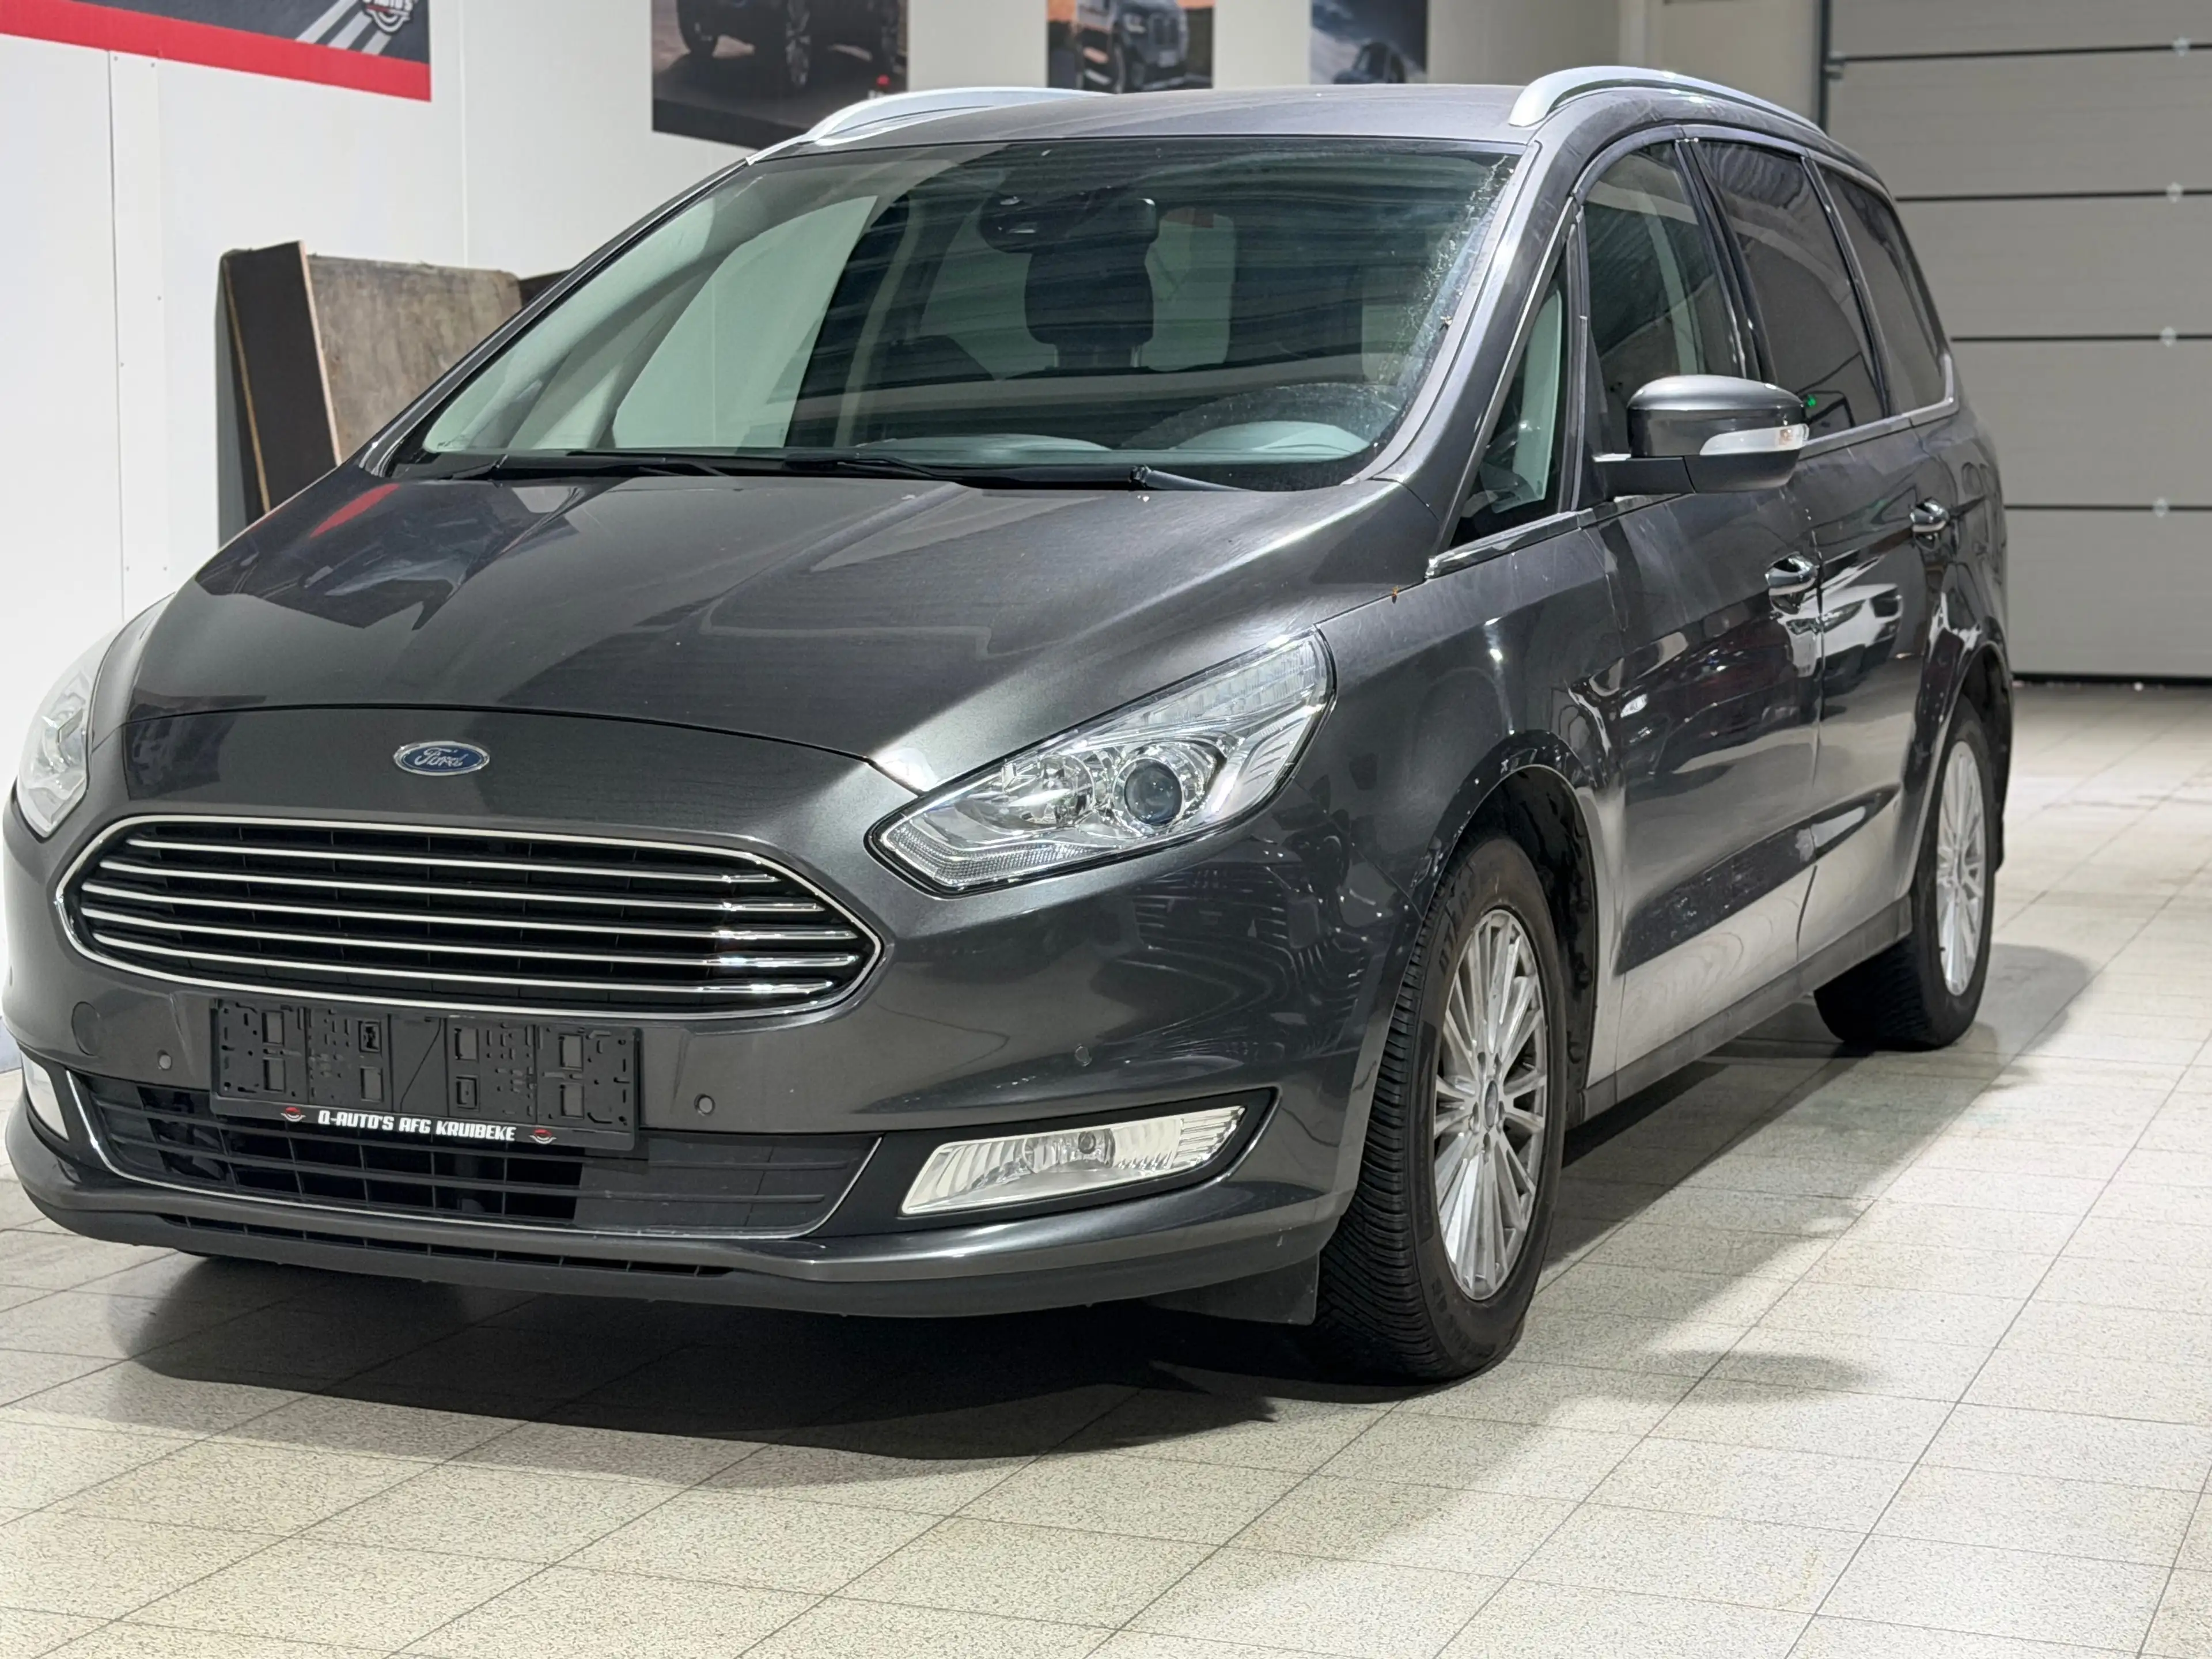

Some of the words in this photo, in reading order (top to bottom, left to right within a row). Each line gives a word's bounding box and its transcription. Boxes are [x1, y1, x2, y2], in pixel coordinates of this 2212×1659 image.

[414, 748, 469, 767] Ford
[317, 1109, 395, 1131] Q-AUTO'S
[398, 1117, 432, 1134] AFG
[435, 1120, 517, 1142] KRUIBEKE
